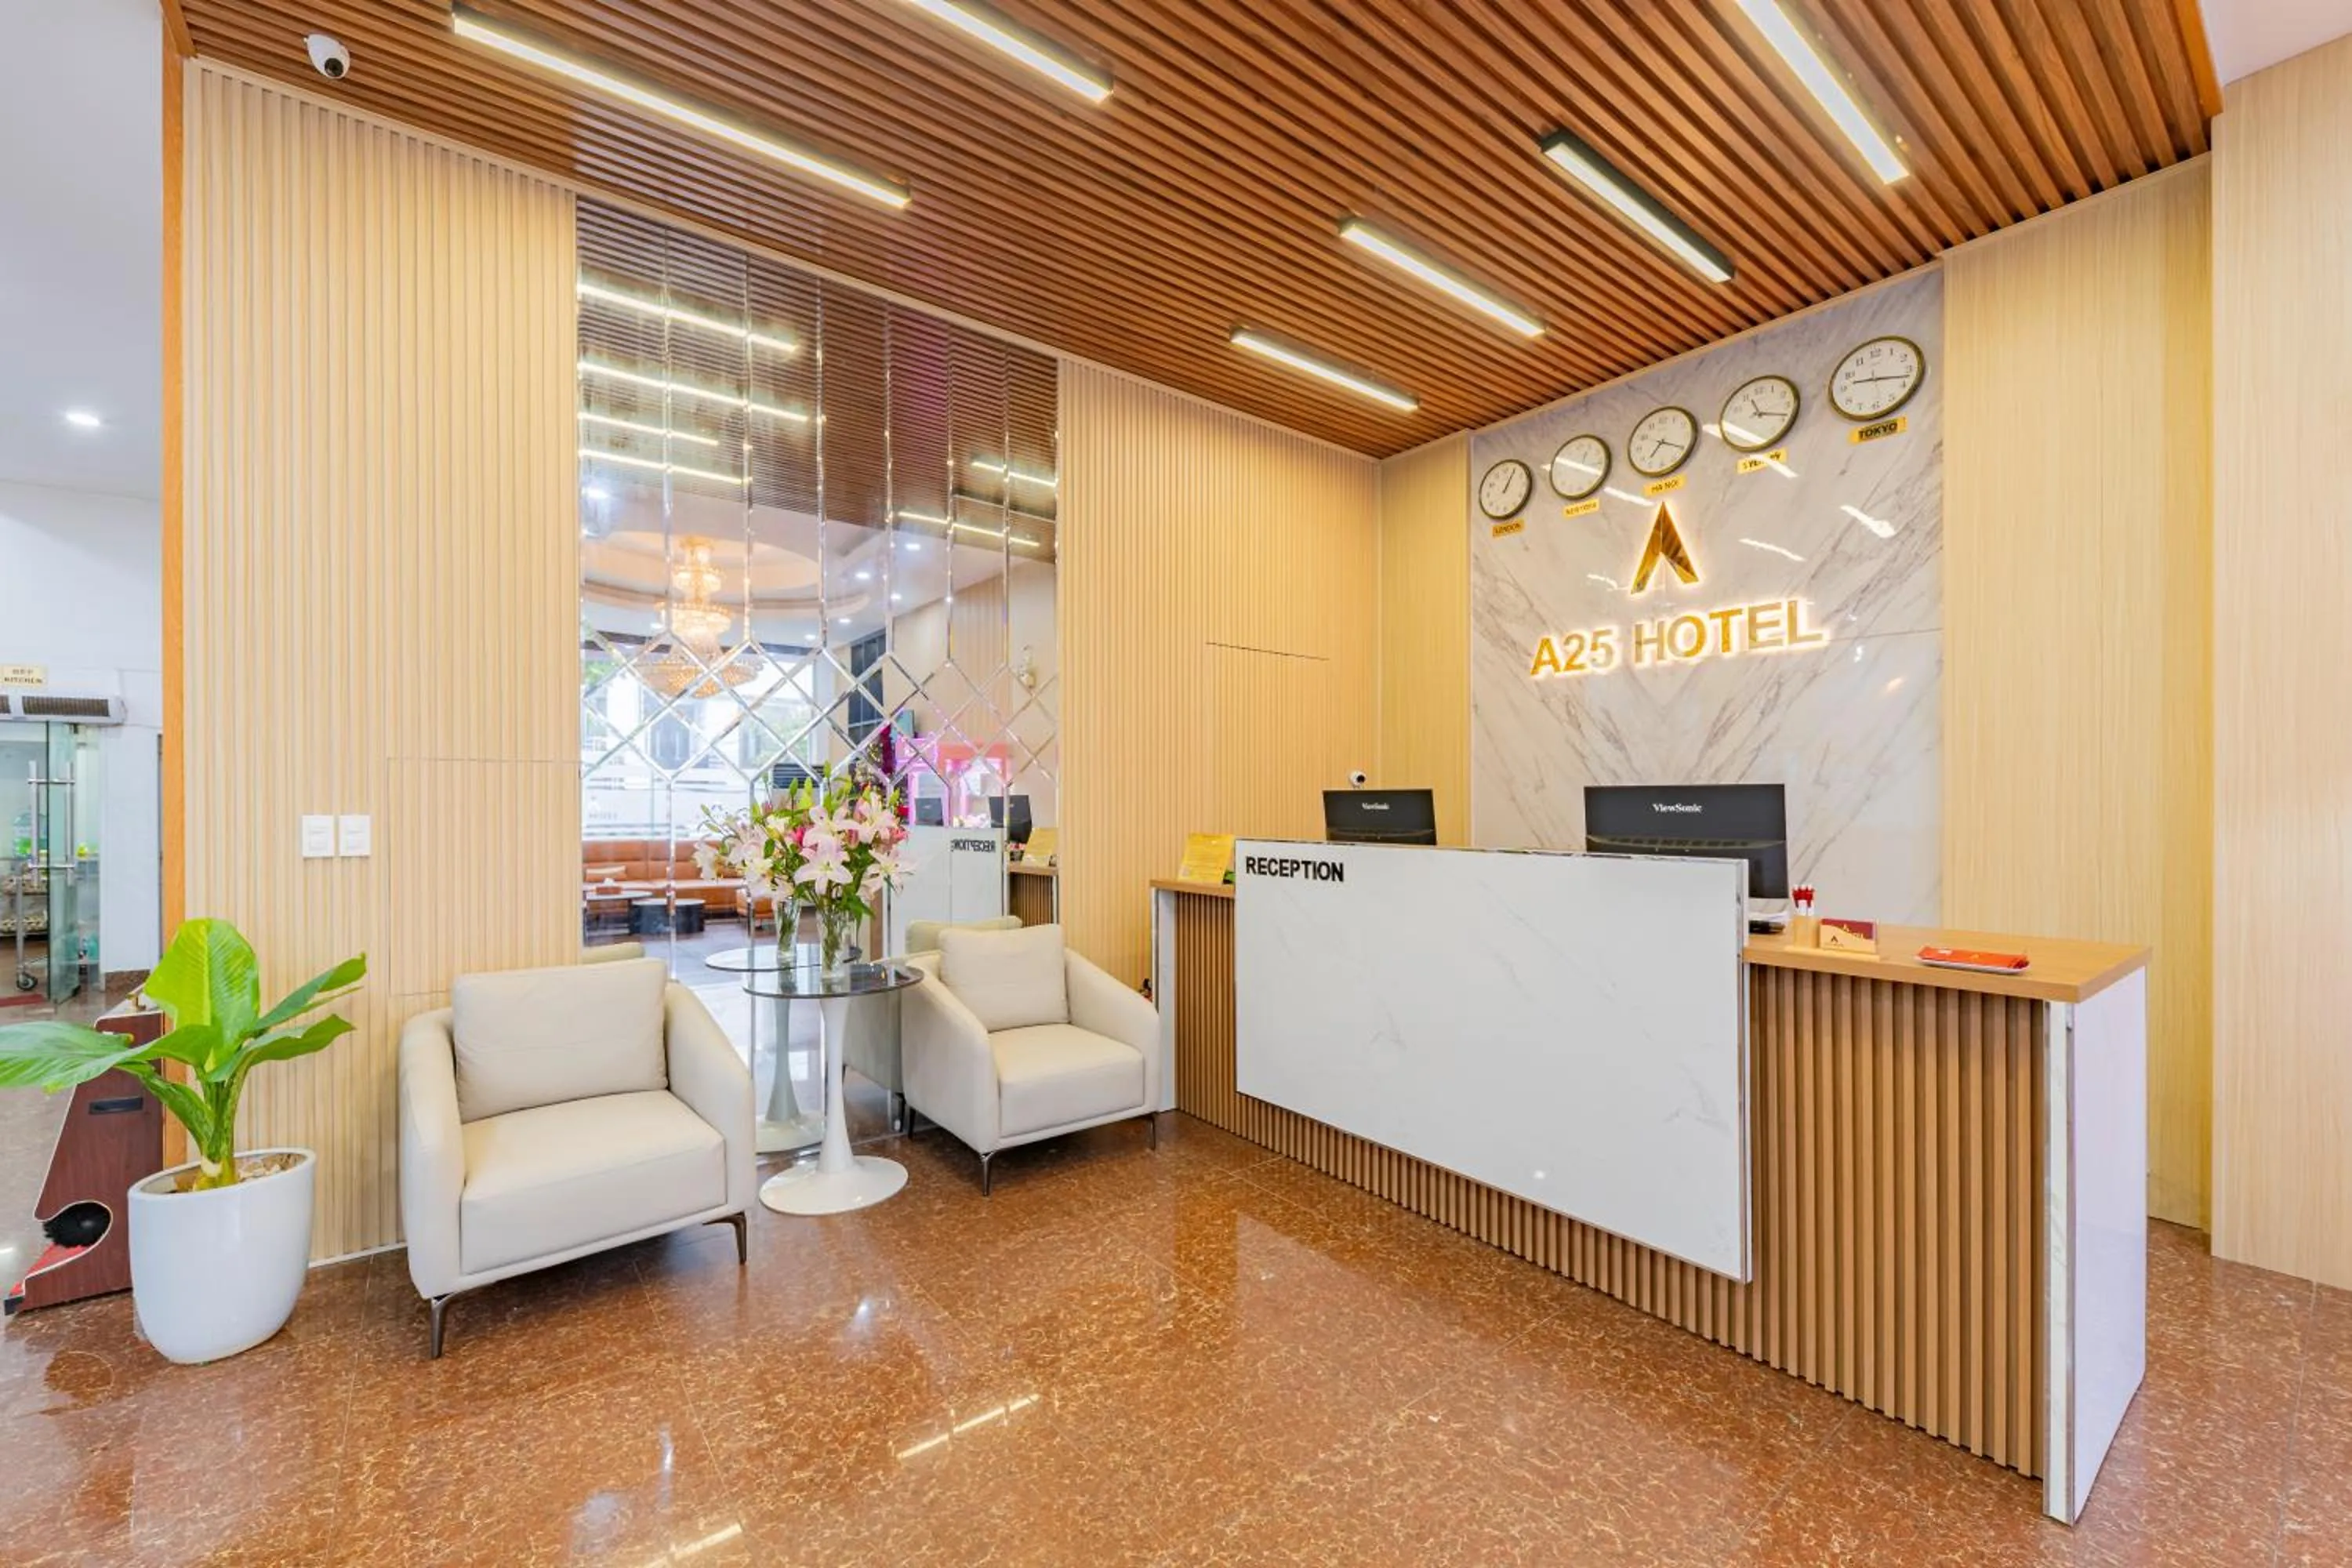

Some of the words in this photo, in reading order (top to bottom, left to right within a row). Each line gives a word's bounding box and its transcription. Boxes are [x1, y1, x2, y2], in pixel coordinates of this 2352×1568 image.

[1858, 423, 1898, 441] TOKYO
[1530, 628, 1615, 676] A25
[1634, 599, 1824, 664] HOTEL
[1652, 803, 1702, 812] ViewSonic
[1245, 855, 1345, 883] RECEPTION
